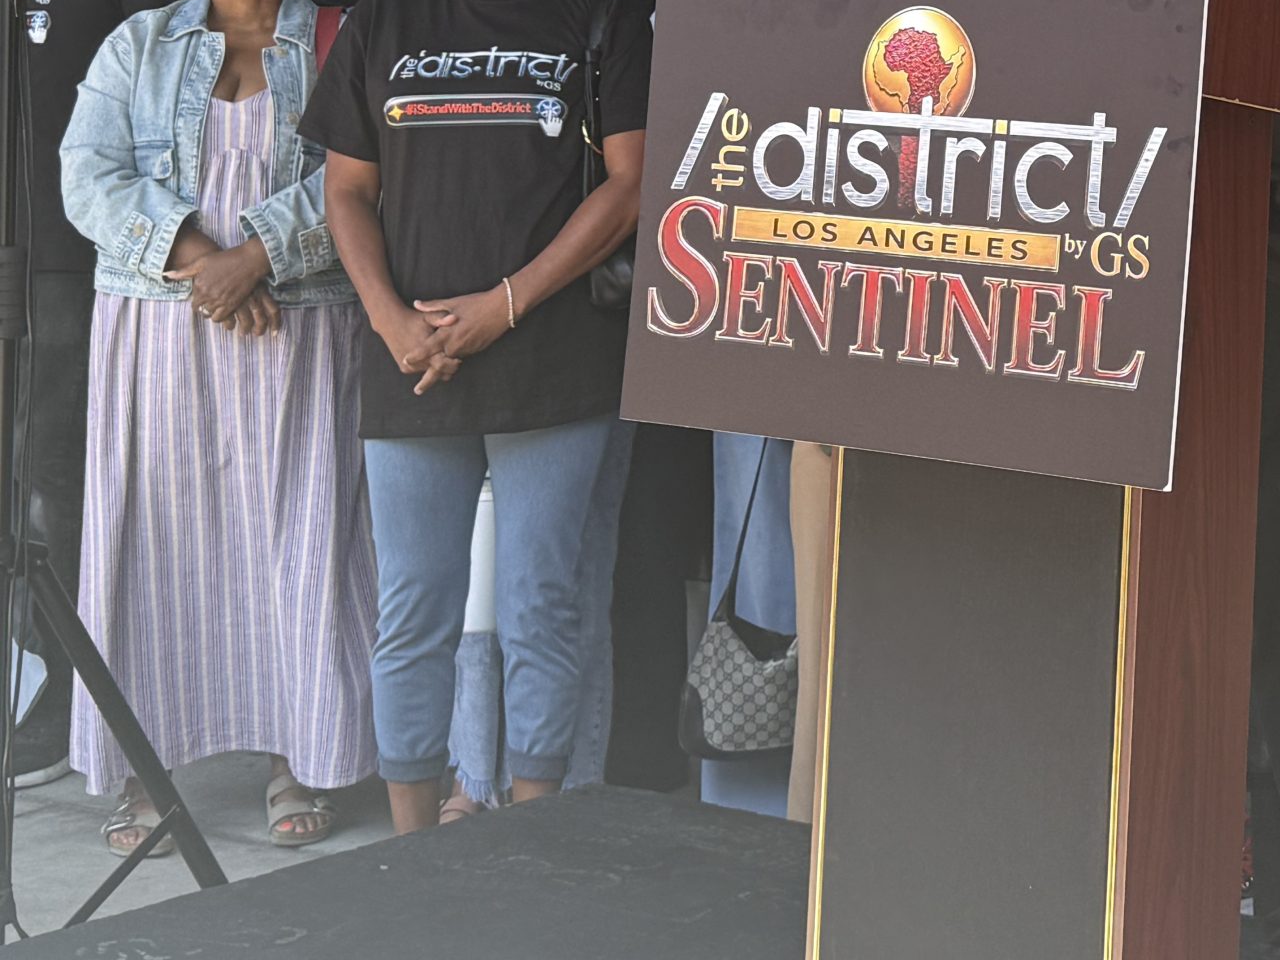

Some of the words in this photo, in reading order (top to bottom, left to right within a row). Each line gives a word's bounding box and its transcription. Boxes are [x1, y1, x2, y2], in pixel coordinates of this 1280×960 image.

[771, 218, 838, 243] LOS
[857, 226, 1030, 262] ANGELES
[1063, 233, 1087, 260] by
[1089, 232, 1151, 280] GS
